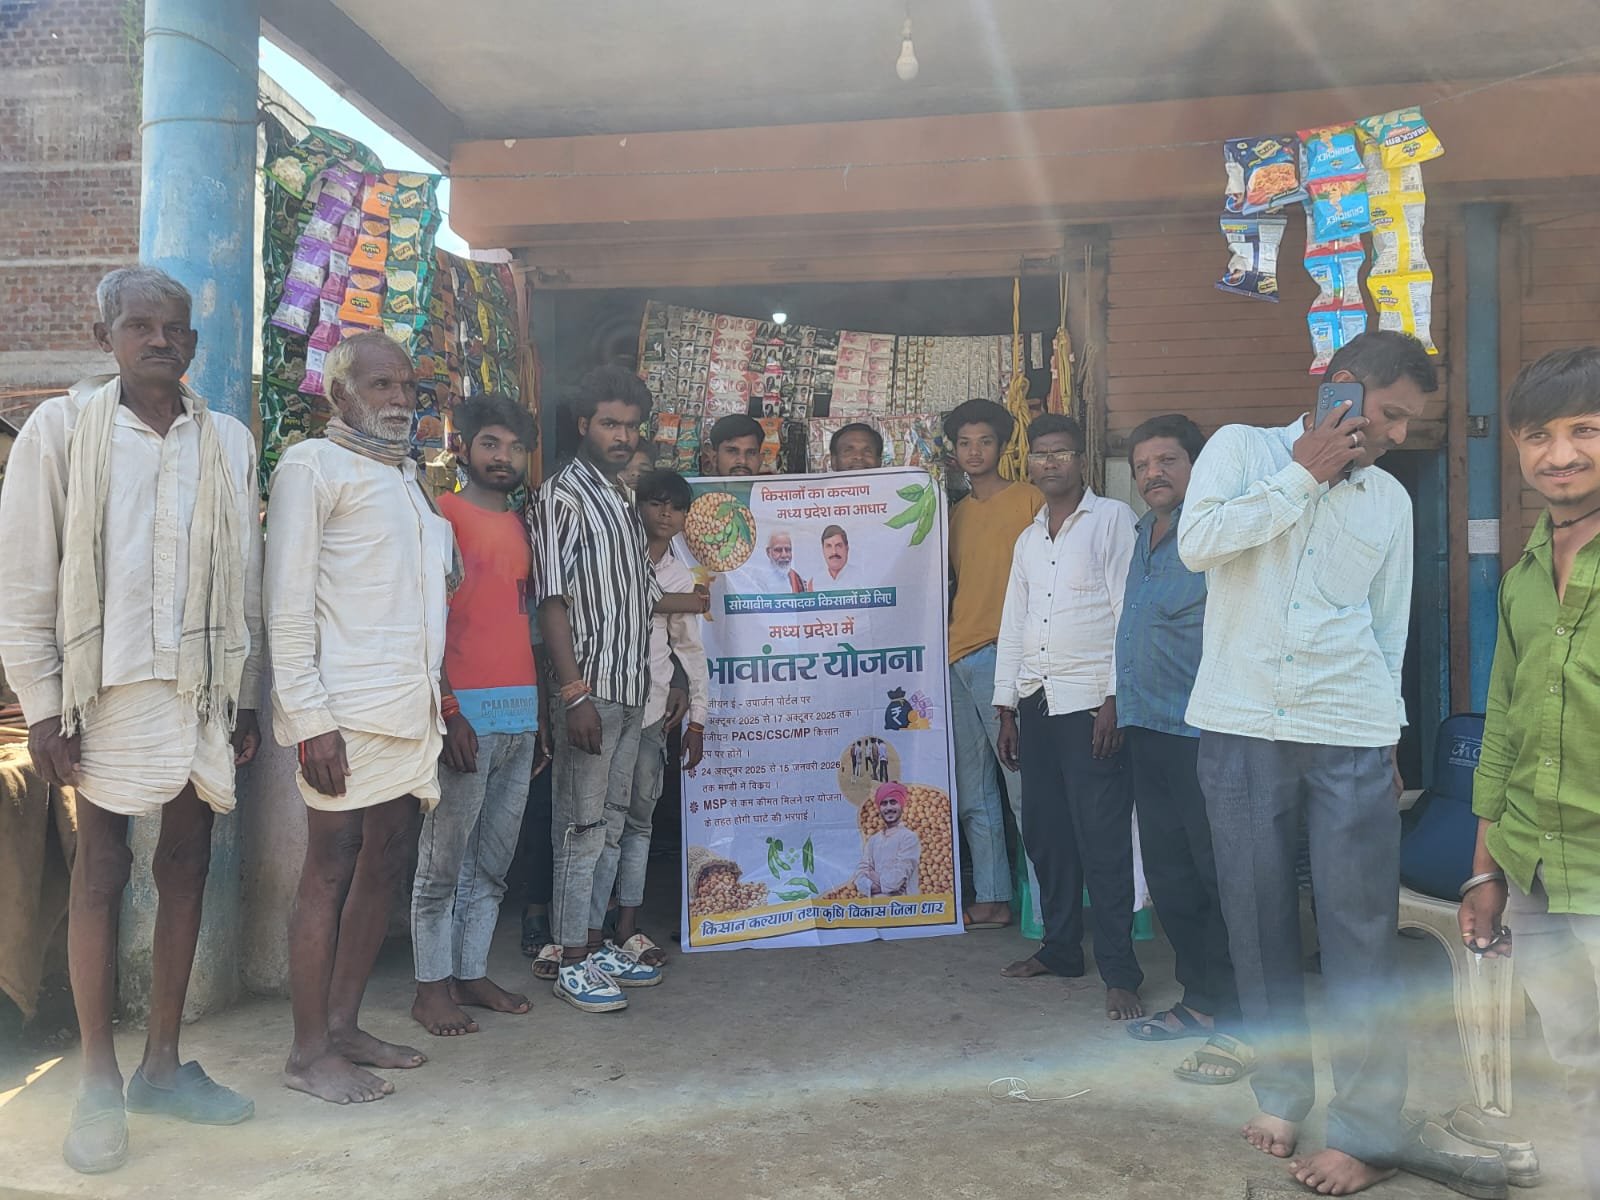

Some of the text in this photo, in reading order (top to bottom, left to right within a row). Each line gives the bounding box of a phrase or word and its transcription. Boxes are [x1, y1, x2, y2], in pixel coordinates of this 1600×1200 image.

[761, 484, 870, 502] किसानों का कल्याण
[777, 502, 888, 520] मध्य प्रदेश का आधार
[774, 597, 816, 609] उत्पादक
[818, 591, 858, 606] किसानों
[859, 590, 872, 604] के
[873, 589, 892, 604] लिए
[769, 616, 855, 639] मध्य प्रदेश में
[822, 643, 926, 678] योजना
[800, 695, 812, 704] पर
[738, 716, 760, 725] 2025
[763, 713, 770, 723] से
[774, 714, 782, 723] 17
[786, 712, 814, 724] अक्टूबर
[816, 711, 837, 721] 2025
[838, 710, 854, 718] तक
[731, 727, 811, 741] PACS/CSC/MP
[813, 726, 840, 737] किसान
[701, 760, 841, 777] 24 अक्टूबर 2025 से 15 जनवरी 2026
[702, 784, 716, 793] तक
[703, 792, 842, 810] MSP से कम कीमत मिलने पर योजना
[704, 816, 712, 827] के
[714, 817, 731, 827] तहत
[734, 813, 750, 825] होगी
[771, 811, 782, 823] की
[784, 809, 809, 821] भरपाई
[701, 901, 945, 937] किसान कल्याण तथा कृषि विकास जिला धार
